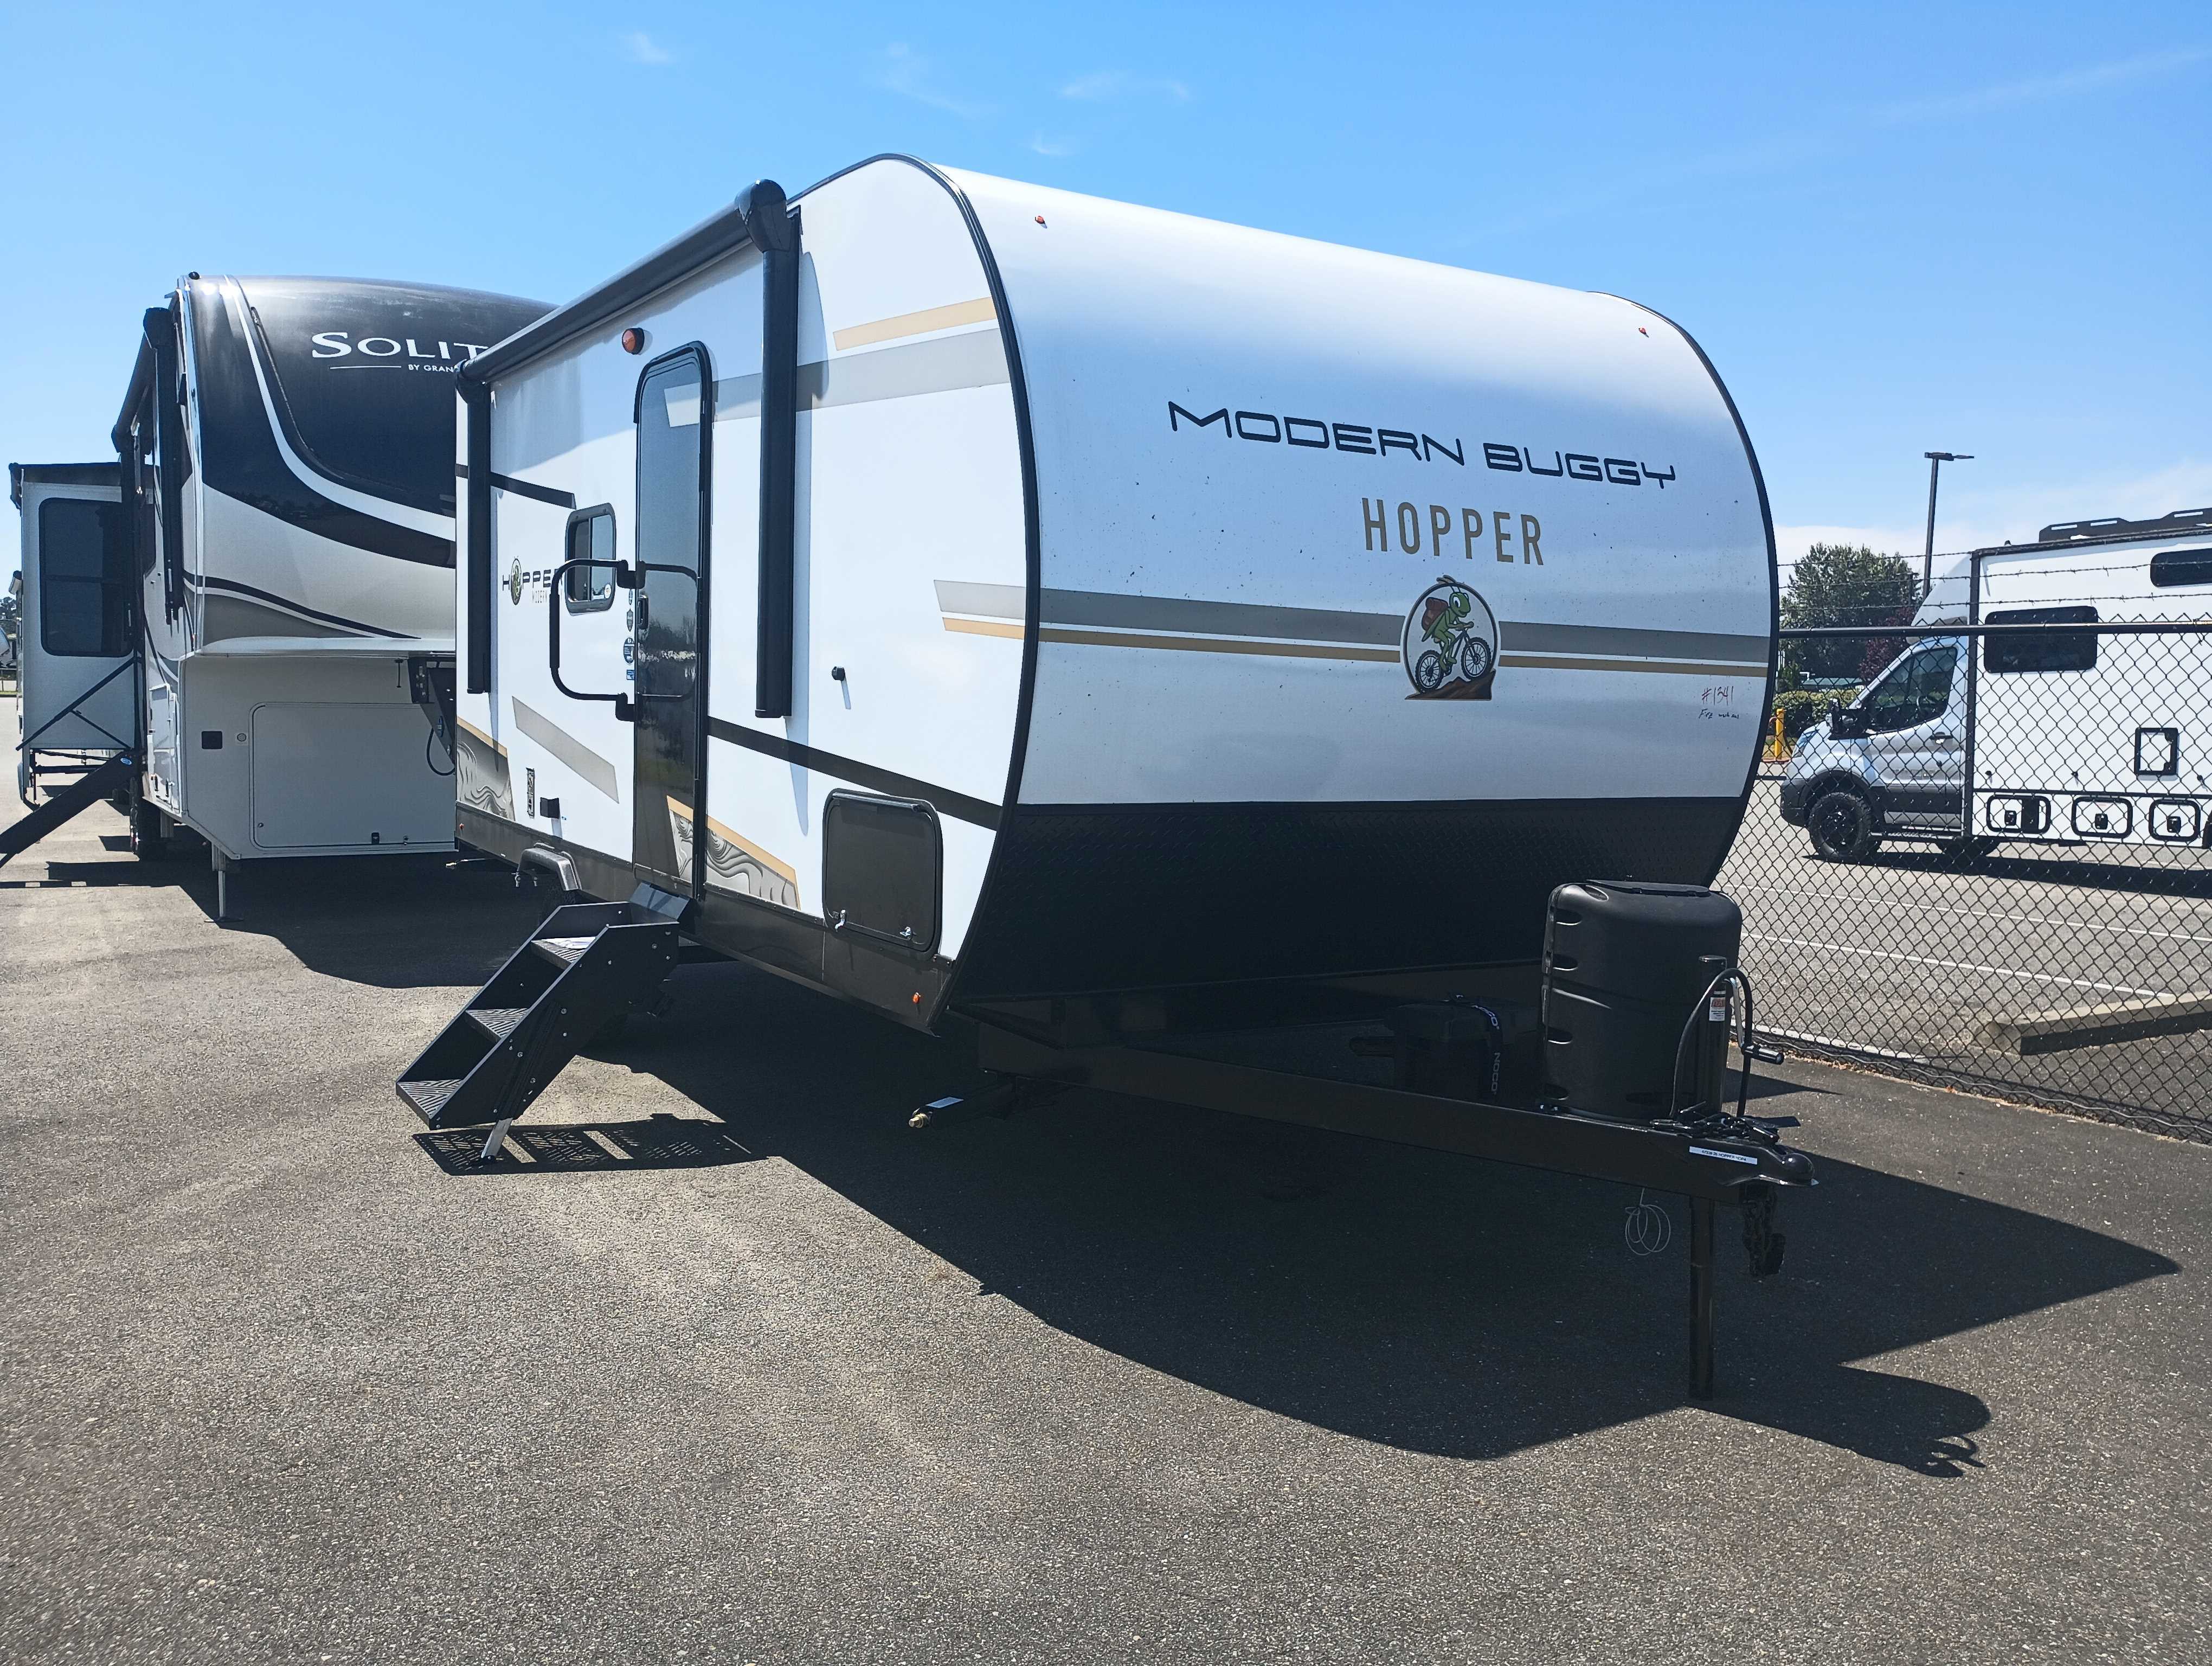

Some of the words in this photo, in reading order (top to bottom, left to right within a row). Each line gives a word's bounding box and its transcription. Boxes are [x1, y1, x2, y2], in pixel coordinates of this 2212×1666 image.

[1168, 401, 1465, 466] MODERN
[1483, 443, 1676, 489] BUGGY
[1362, 497, 1544, 566] HOPPER
[1491, 1052, 1501, 1092] NOCO
